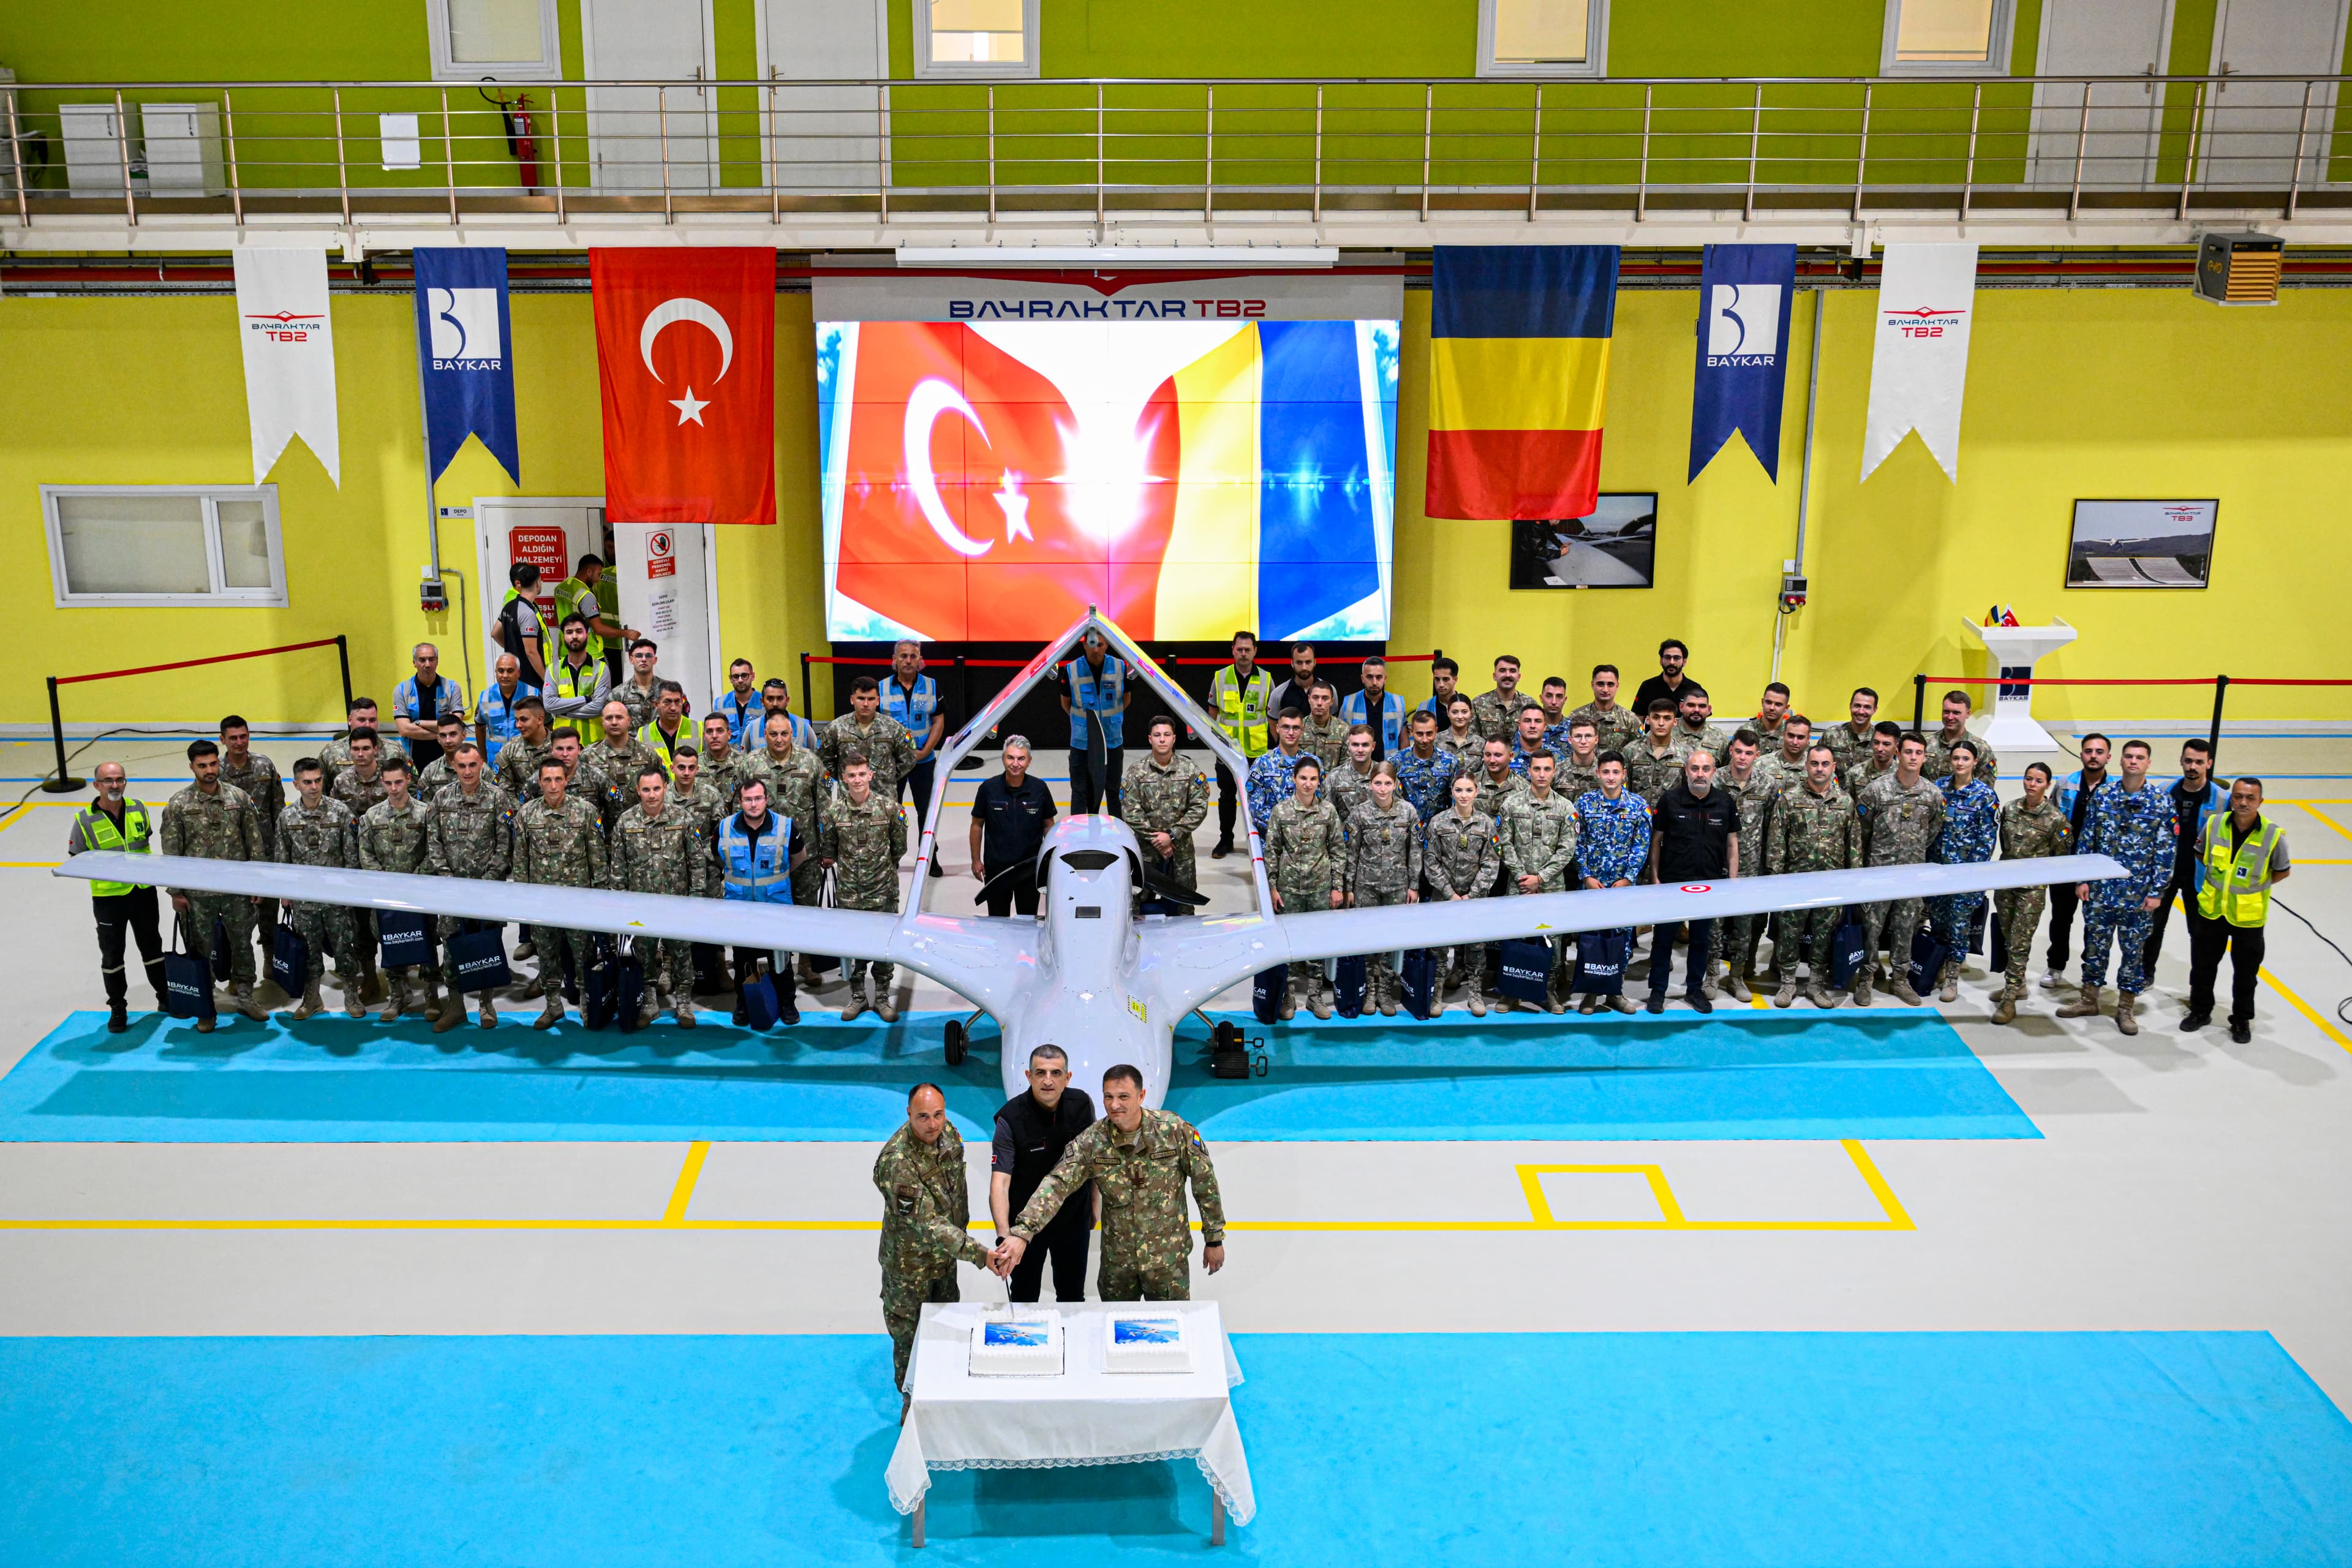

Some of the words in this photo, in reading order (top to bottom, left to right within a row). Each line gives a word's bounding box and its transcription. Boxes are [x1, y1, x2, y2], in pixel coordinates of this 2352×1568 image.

[949, 300, 1186, 318] BAYRAKTAR
[1193, 300, 1266, 317] TB2
[265, 331, 307, 342] TB2
[1901, 327, 1943, 337] TB2
[433, 360, 502, 371] BAYKAR
[1706, 356, 1774, 366] BAYKAR
[522, 544, 554, 553] ALDIĞIN
[515, 554, 562, 564] MALZEMEYİ
[386, 930, 423, 940] BAYKAR
[466, 956, 500, 968] BAYKAR
[1509, 967, 1544, 978] BAYKAR
[1591, 963, 1618, 972] BAYKAR
[171, 982, 200, 993] BAYKAR
